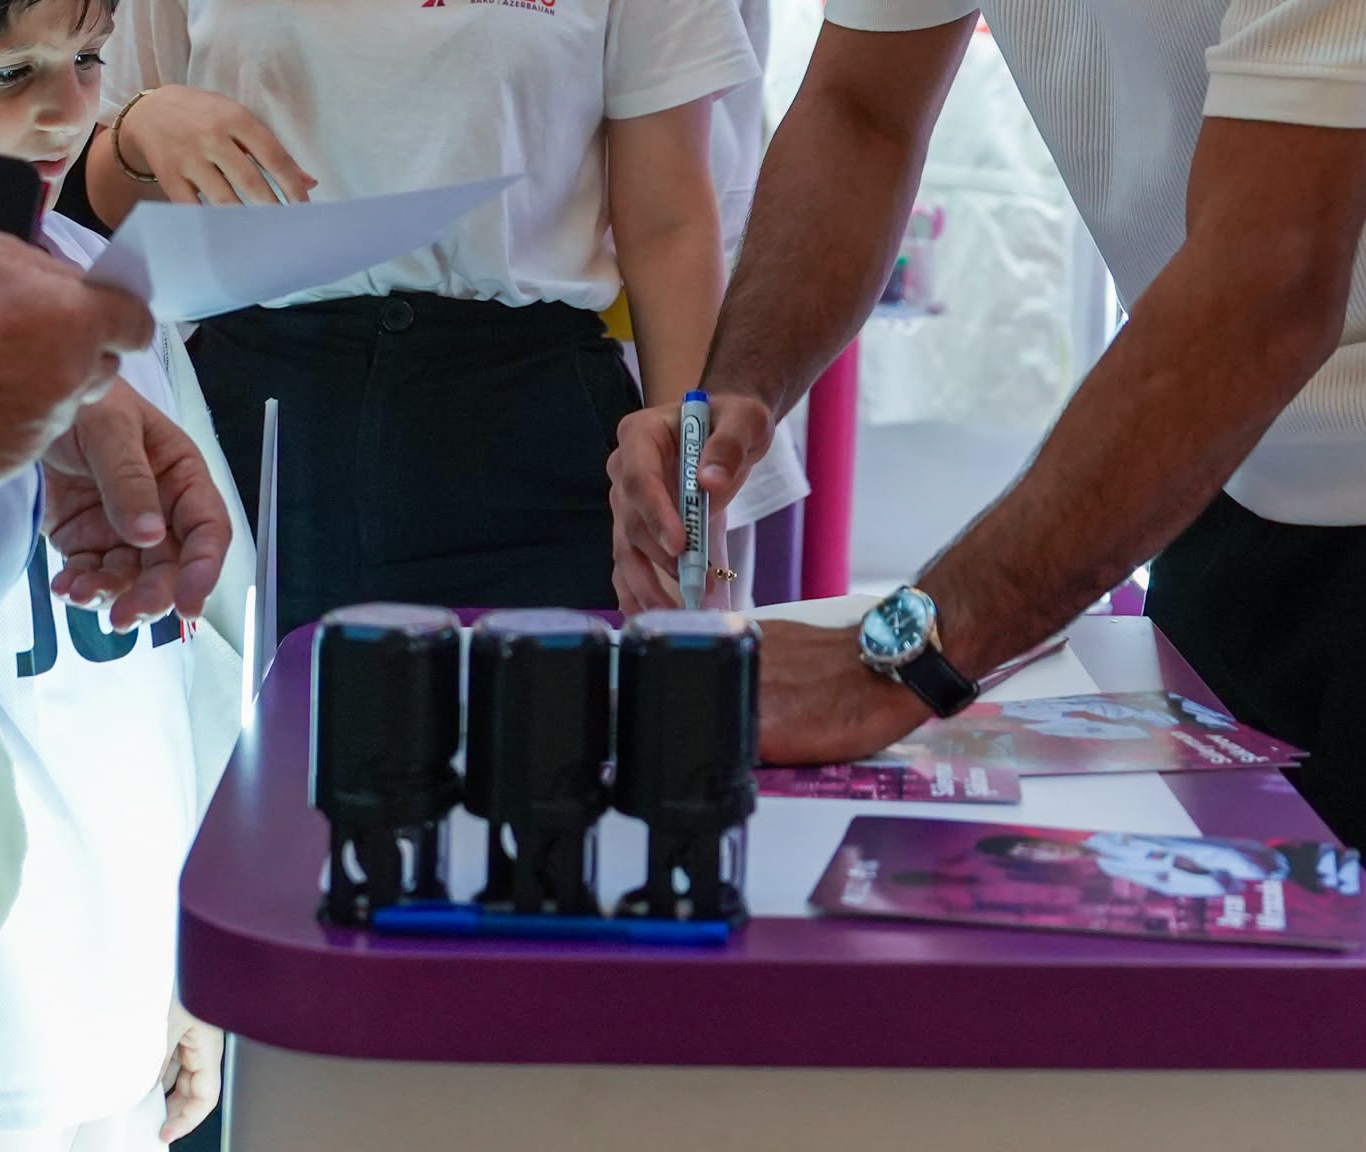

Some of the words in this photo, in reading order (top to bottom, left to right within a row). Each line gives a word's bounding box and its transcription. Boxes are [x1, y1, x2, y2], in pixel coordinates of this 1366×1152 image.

[502, 0, 556, 17] AZERBAIJAN
[684, 414, 702, 491] BOARD
[685, 495, 700, 552] WHITE
